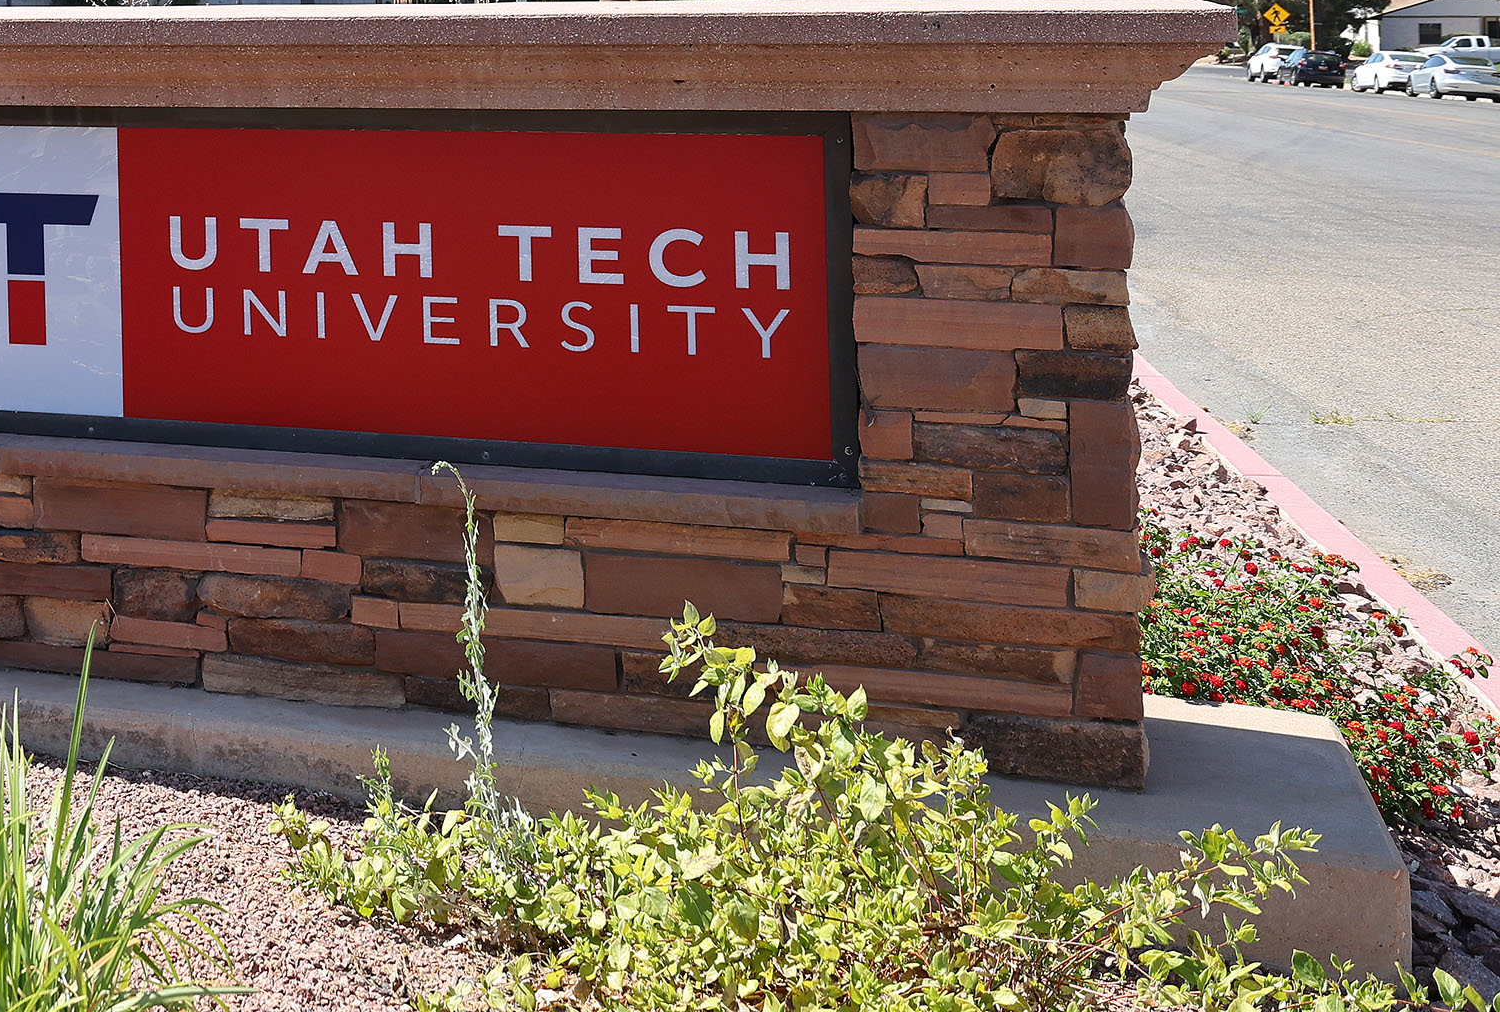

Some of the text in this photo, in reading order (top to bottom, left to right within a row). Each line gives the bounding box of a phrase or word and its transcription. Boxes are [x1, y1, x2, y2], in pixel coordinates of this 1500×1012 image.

[169, 215, 791, 291] UTAH TECH
[172, 285, 791, 359] UNIVERSITY
